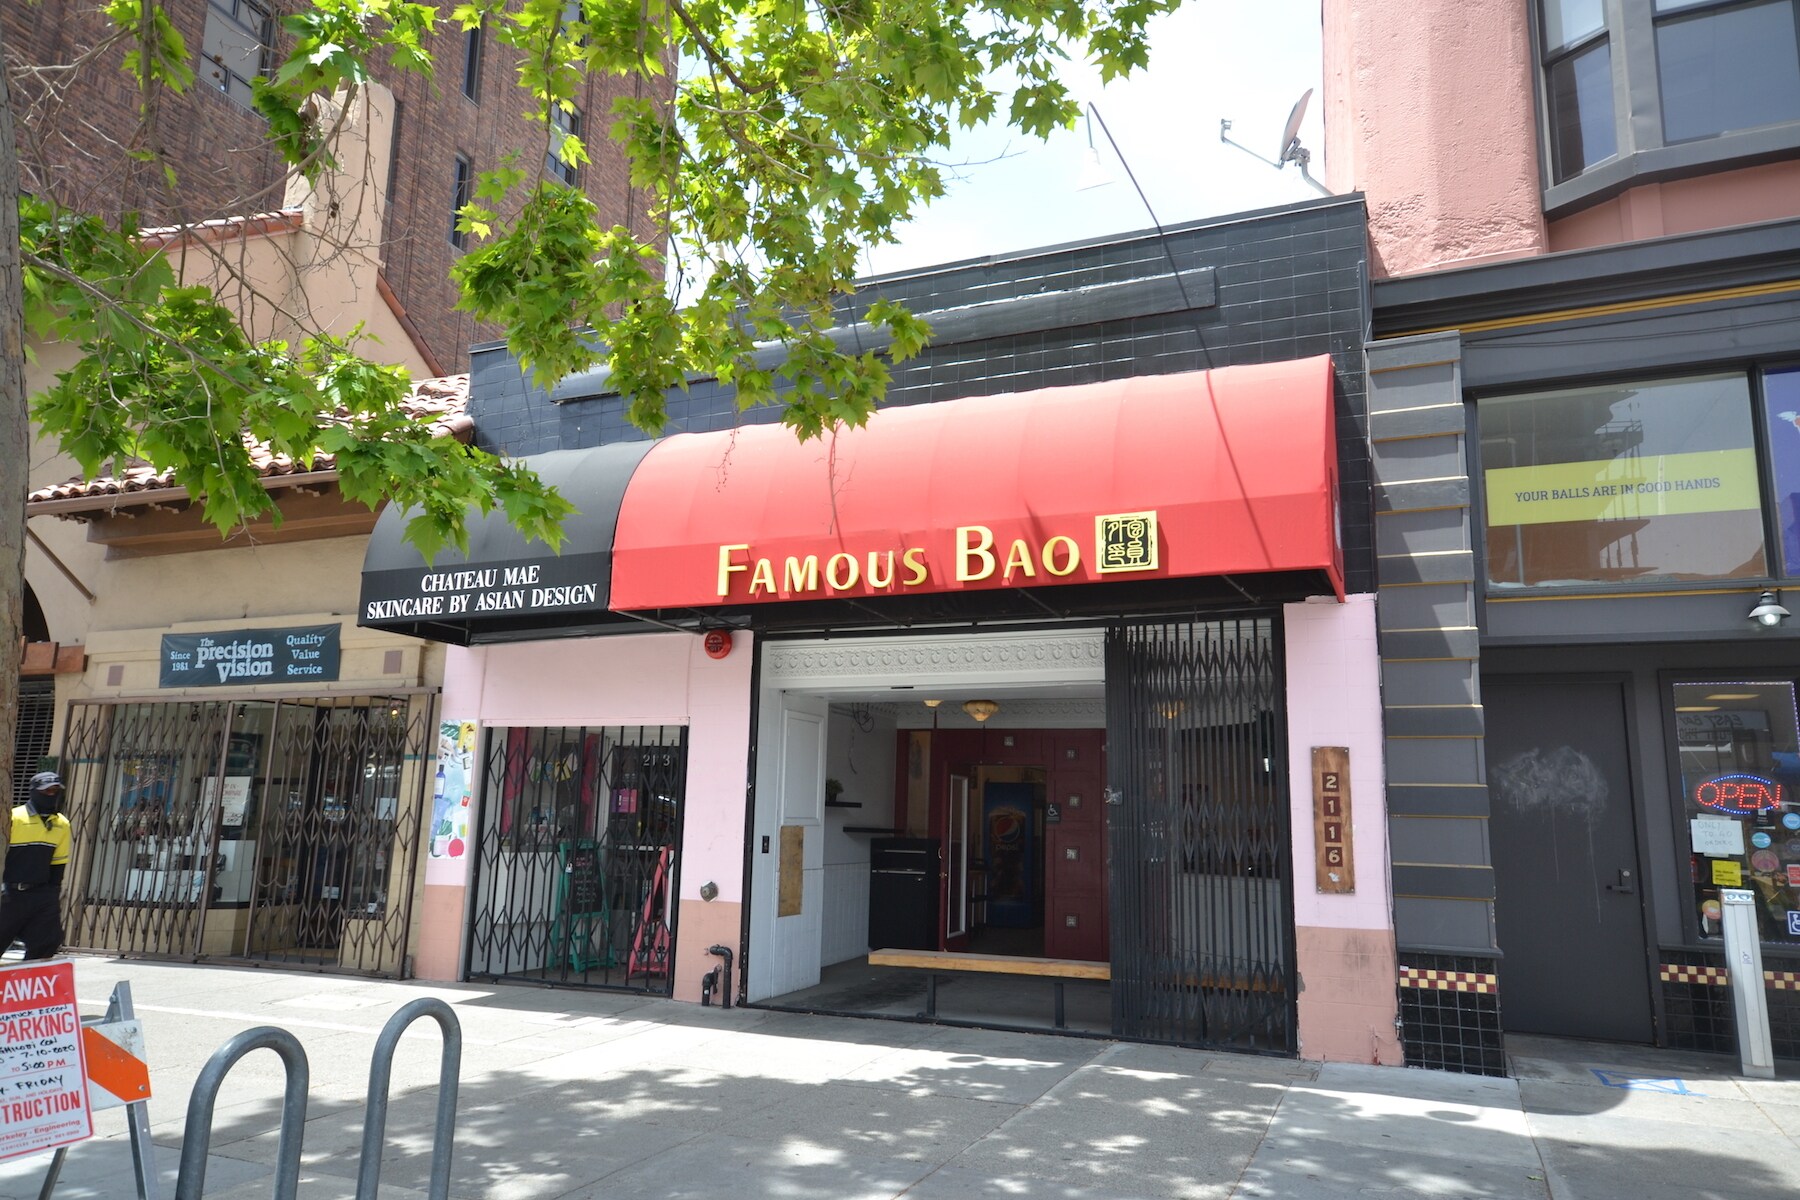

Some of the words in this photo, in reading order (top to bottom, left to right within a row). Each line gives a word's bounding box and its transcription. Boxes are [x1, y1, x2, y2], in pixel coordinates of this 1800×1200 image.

[1515, 490, 1549, 502] YOUR
[1552, 487, 1590, 500] BALLS
[1592, 485, 1617, 497] ARE
[1620, 484, 1634, 495] IN
[1637, 481, 1672, 494] GOOD
[1675, 477, 1721, 491] HANDS
[716, 543, 928, 597] FAMOUS
[955, 524, 1081, 582] BAO
[420, 568, 498, 593] CHATEAU
[502, 565, 541, 587] MAE
[366, 595, 444, 620] SKINCARE
[448, 593, 472, 614] BY
[474, 589, 525, 612] ASIAN
[530, 583, 598, 608] DESIGN
[200, 637, 215, 647] The
[286, 633, 326, 647] Quality
[170, 650, 191, 660] Since
[194, 639, 274, 669] precision
[291, 649, 320, 660] Value
[171, 662, 189, 672] 1981
[215, 658, 274, 684] vision
[286, 663, 323, 676] Service
[1696, 781, 1782, 810] OPEN
[1324, 774, 1341, 864] 2116
[15, 1074, 64, 1090] FRIDAY
[0, 1090, 81, 1124] TRUCTION
[34, 1119, 81, 1135] Engineering
